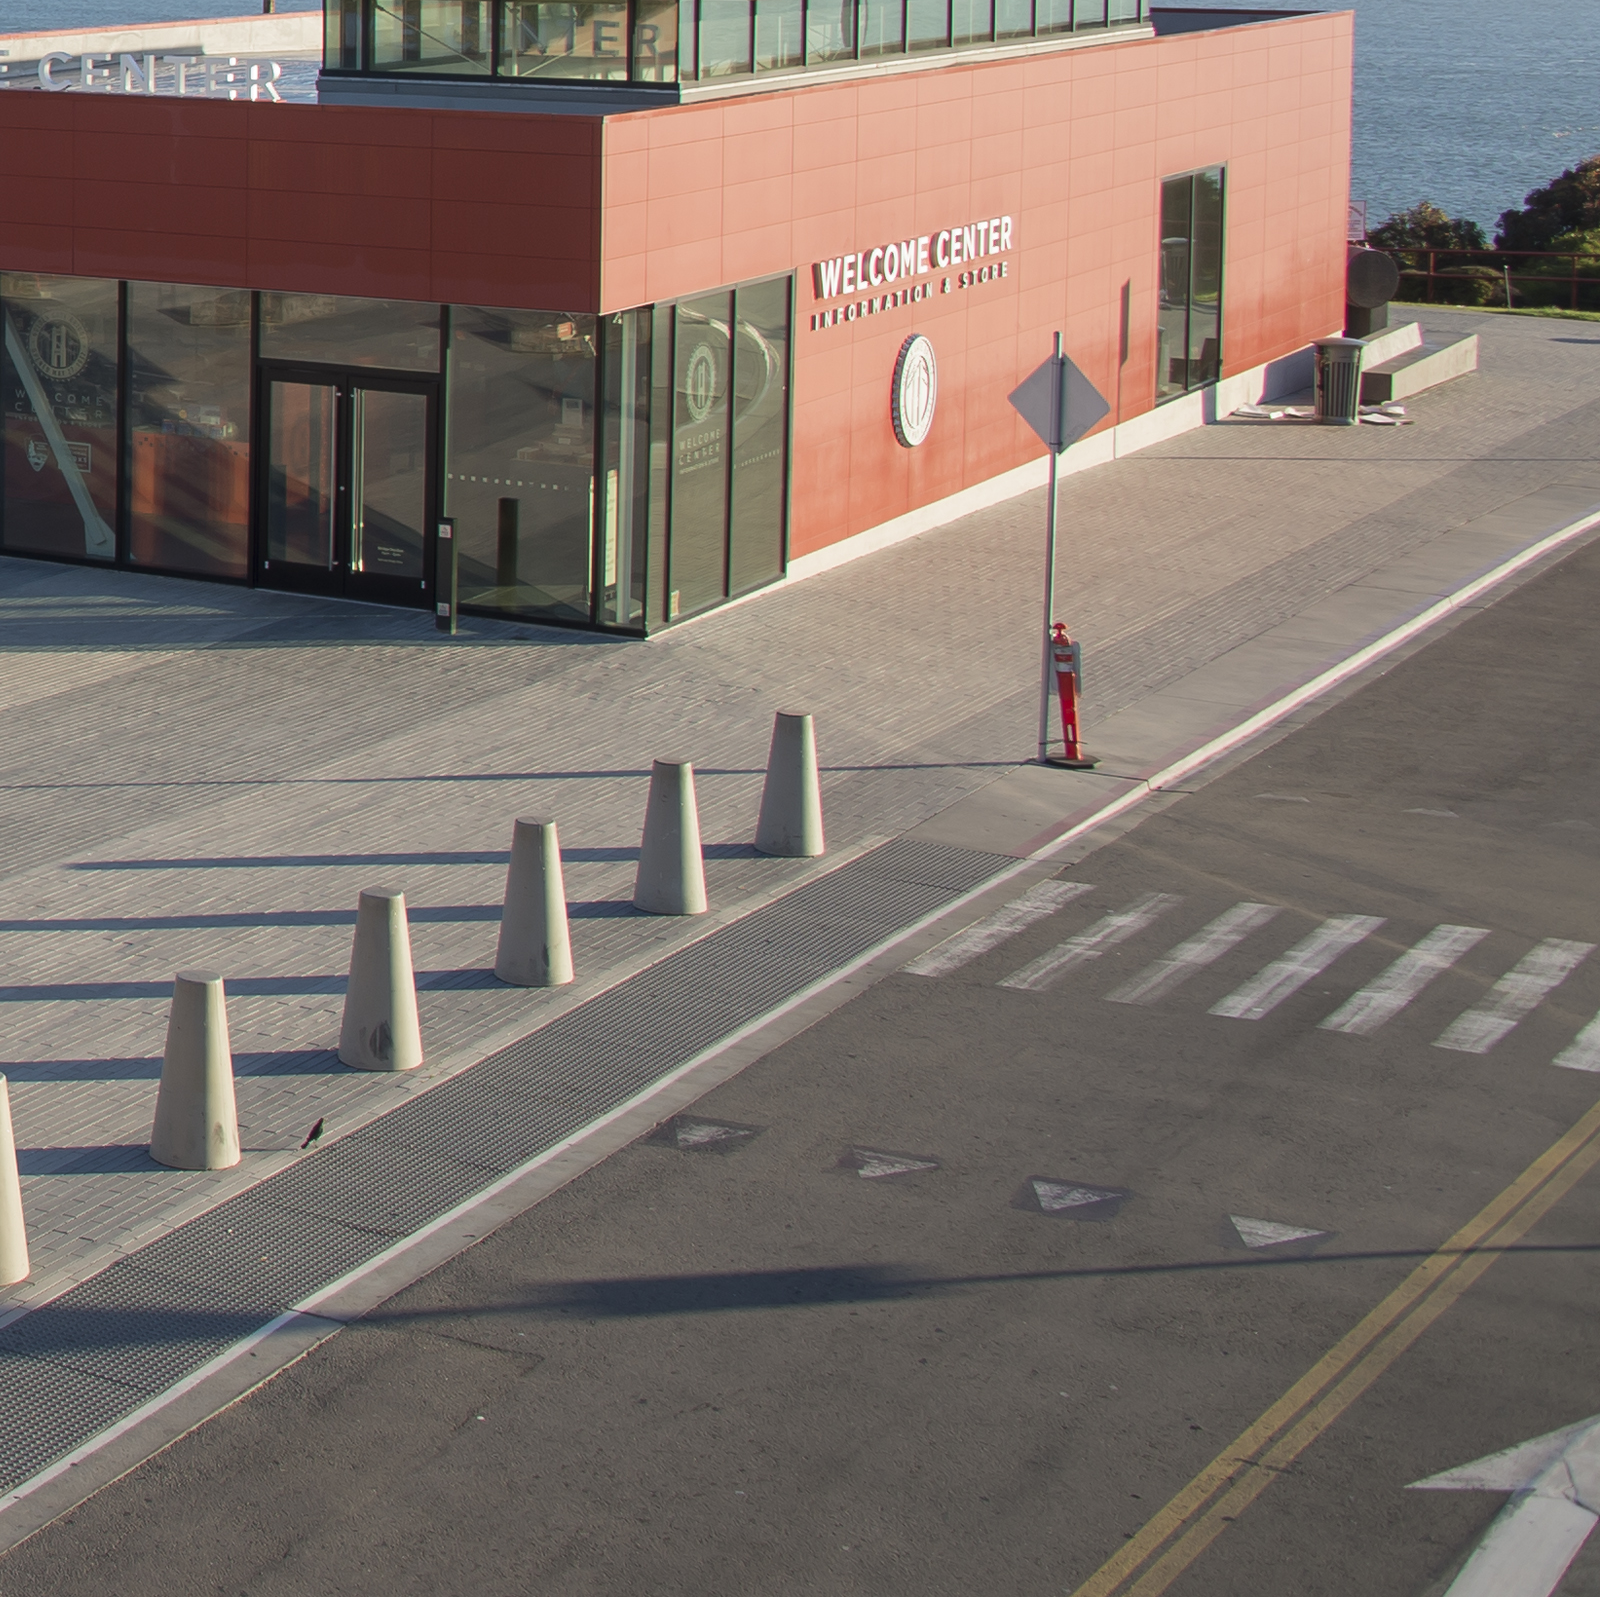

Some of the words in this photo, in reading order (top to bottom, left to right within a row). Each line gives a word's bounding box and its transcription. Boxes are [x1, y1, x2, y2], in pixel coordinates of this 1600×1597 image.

[36, 51, 284, 102] CENTER
[818, 235, 930, 300] WELCOME
[936, 215, 1013, 268] CENTER
[812, 282, 933, 332] INFORMATION
[942, 277, 951, 294] &
[961, 261, 1008, 289] STORE
[15, 389, 103, 406] WCOME
[678, 428, 721, 451] WELCOME
[678, 442, 720, 466] CENTER
